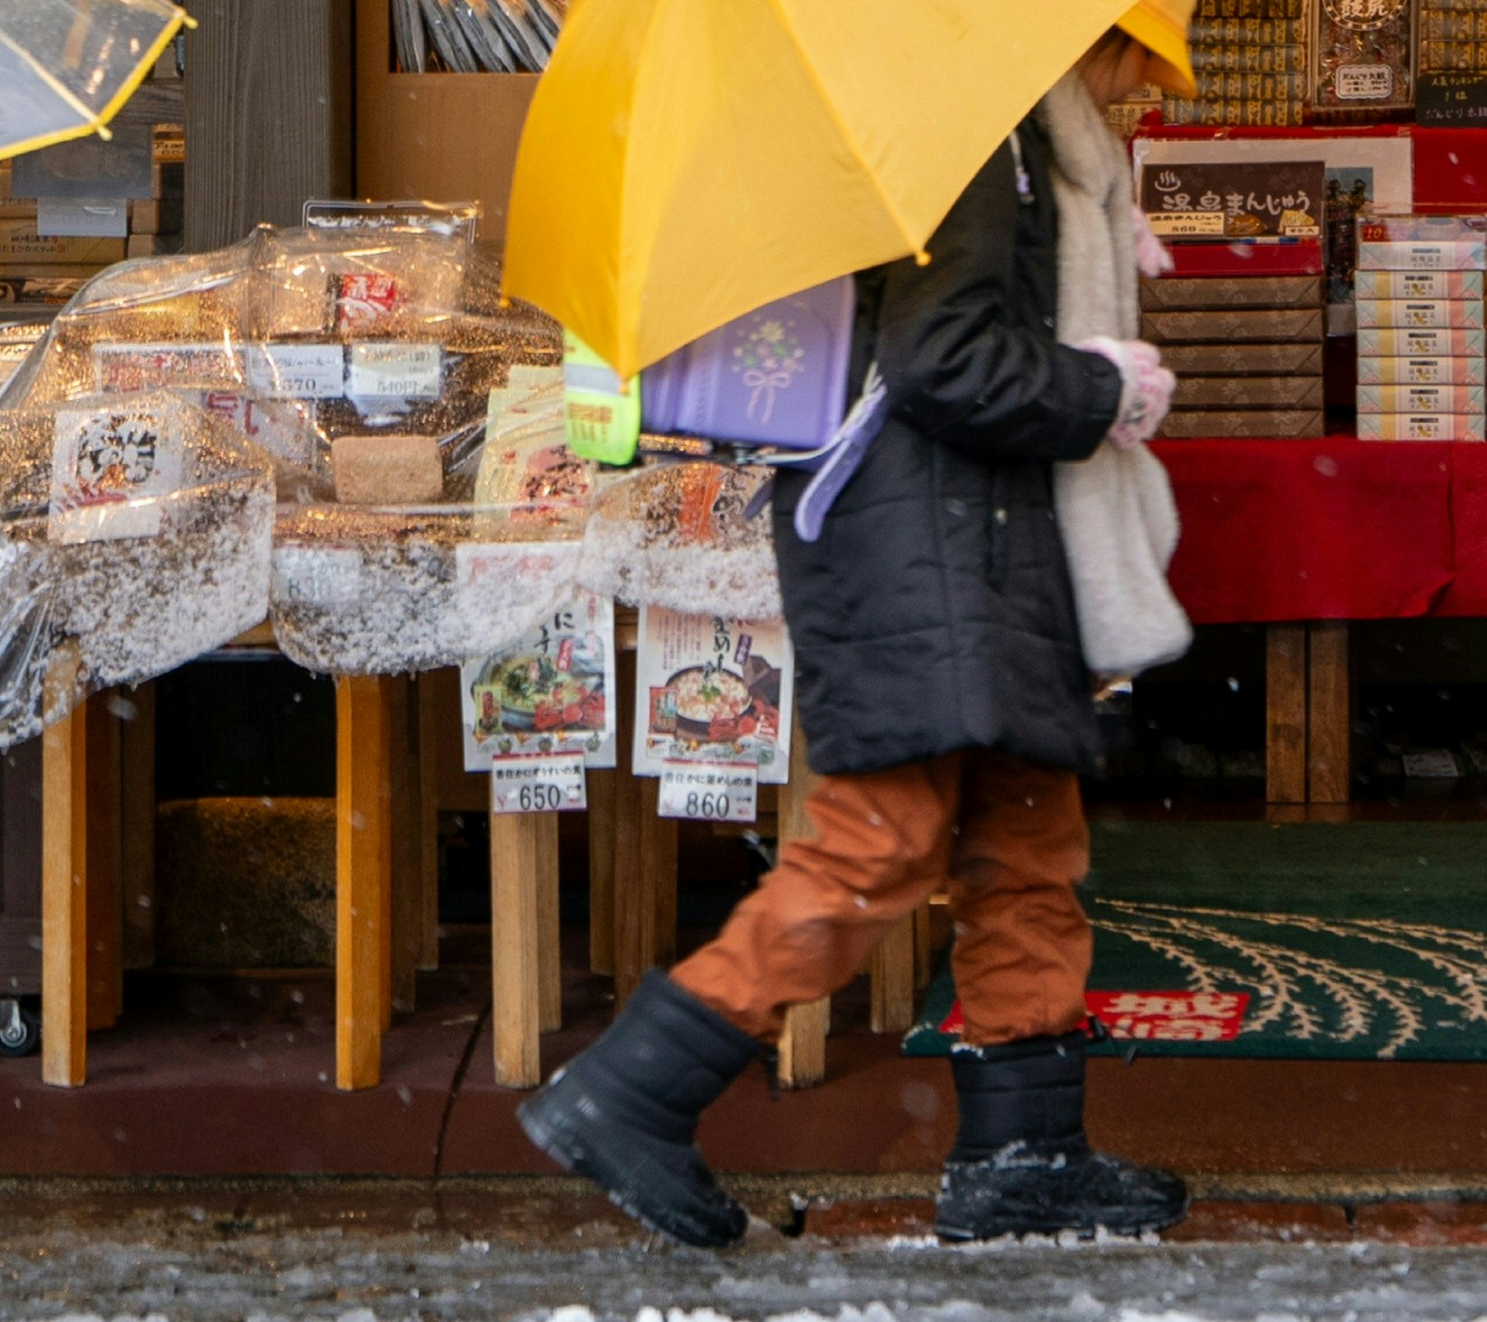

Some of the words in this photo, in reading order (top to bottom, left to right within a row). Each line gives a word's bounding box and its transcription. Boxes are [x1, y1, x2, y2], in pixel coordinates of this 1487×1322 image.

[494, 766, 582, 781] 香住かにぞうすいの素
[663, 771, 754, 788] 香住かに釜めしの素
[519, 784, 562, 810] 650
[685, 791, 730, 818] 860
